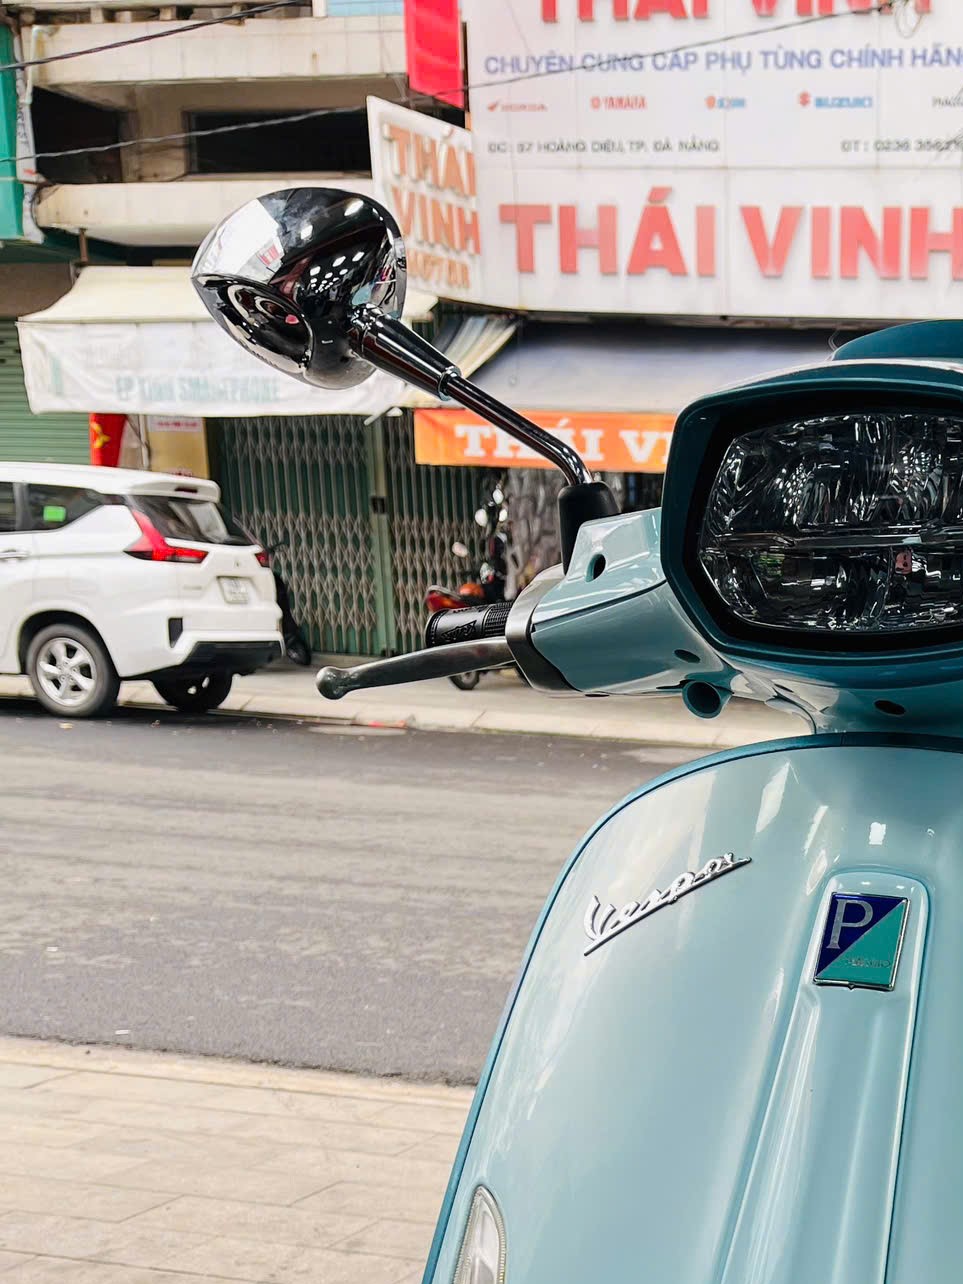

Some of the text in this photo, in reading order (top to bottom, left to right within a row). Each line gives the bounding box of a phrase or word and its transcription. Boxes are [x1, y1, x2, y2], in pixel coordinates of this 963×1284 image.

[484, 51, 574, 75] CHUYÊN
[580, 53, 644, 73] CUNG
[705, 52, 752, 76] PHỤ
[760, 44, 822, 70] TÙNG
[829, 42, 903, 69] CHÍNH
[815, 97, 873, 109] SUZUKI
[387, 124, 477, 197] THÁI
[392, 187, 482, 256] VINH
[500, 186, 716, 279] THÁI
[583, 852, 752, 956] Vespa
[826, 898, 874, 950] P
